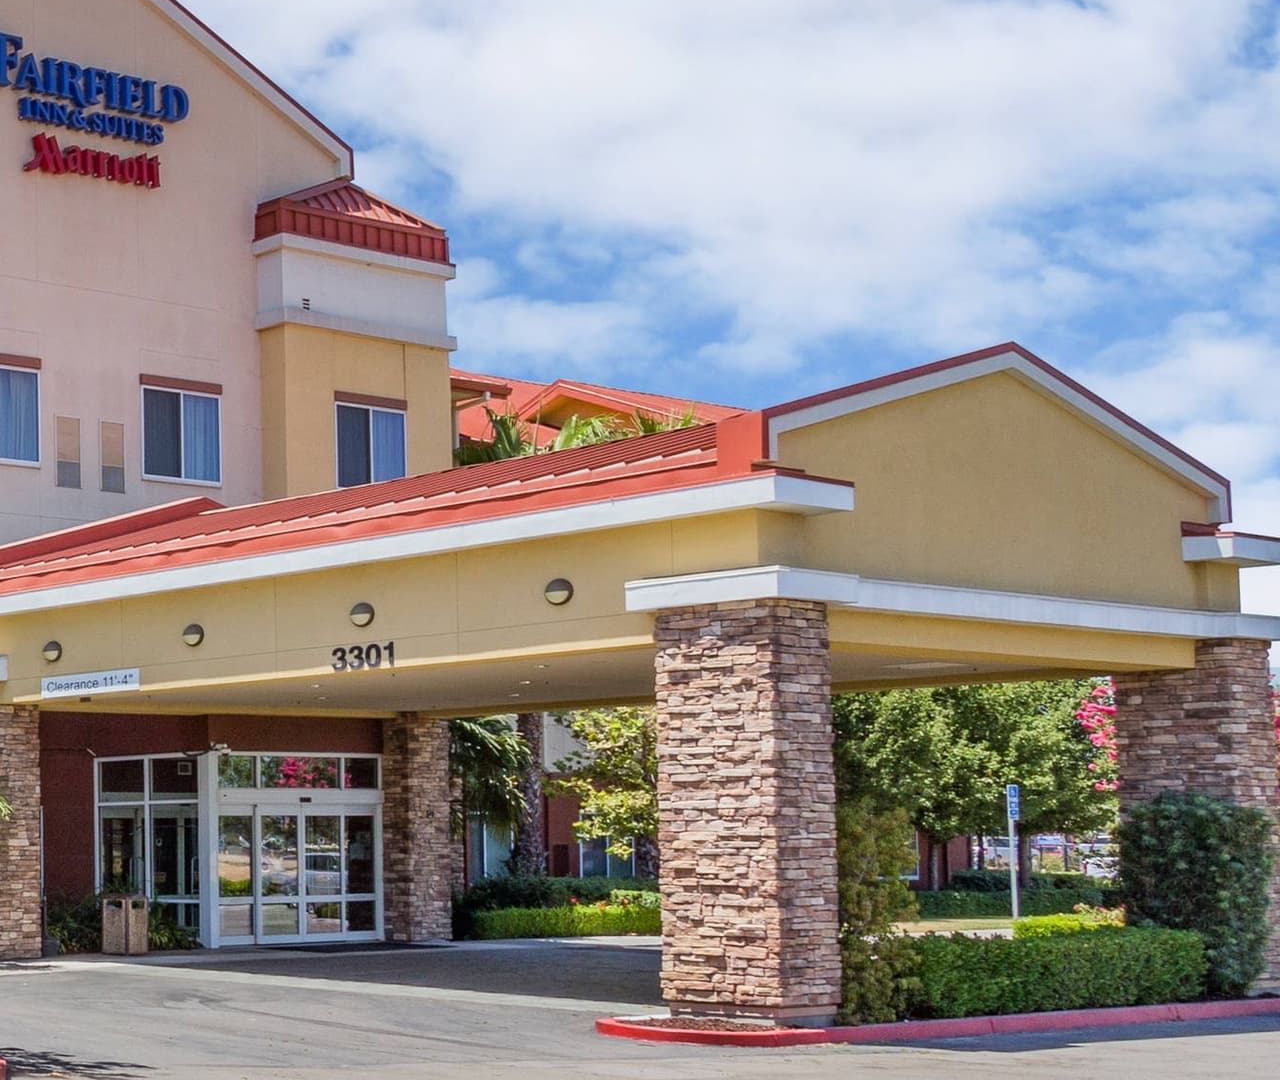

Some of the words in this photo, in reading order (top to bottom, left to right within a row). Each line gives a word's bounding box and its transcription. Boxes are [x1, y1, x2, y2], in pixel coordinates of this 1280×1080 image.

[18, 97, 69, 127] INN
[67, 107, 90, 130] &
[87, 111, 165, 146] SUITES
[23, 132, 162, 189] Marriott
[331, 641, 395, 672] 3301
[46, 678, 100, 694] Clearance
[102, 673, 134, 687] 11'-4"
